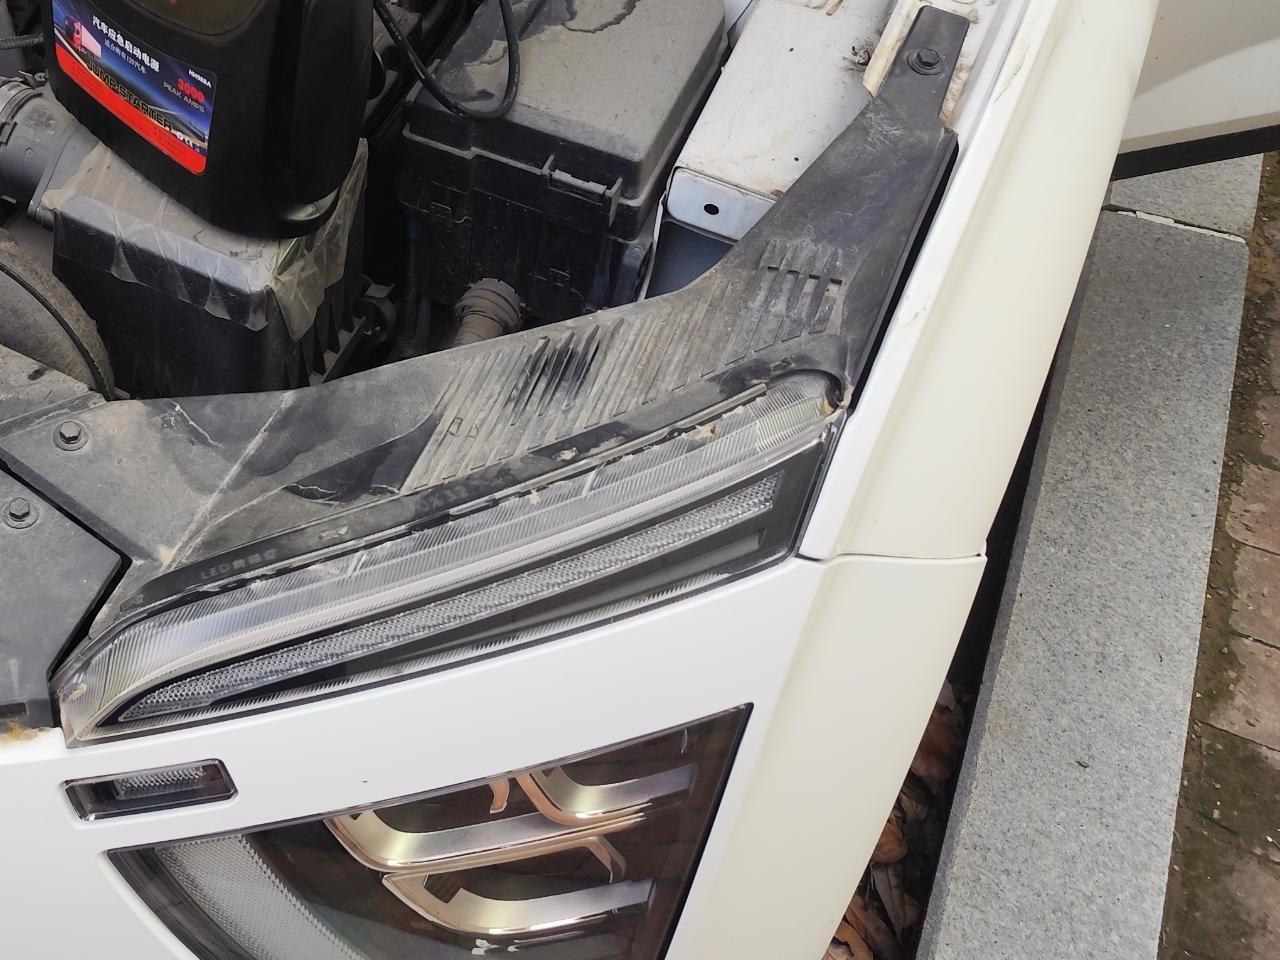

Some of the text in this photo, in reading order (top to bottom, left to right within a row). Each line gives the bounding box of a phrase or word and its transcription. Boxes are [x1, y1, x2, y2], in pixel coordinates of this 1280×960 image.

[92, 15, 160, 73] 汽车应急启动电源
